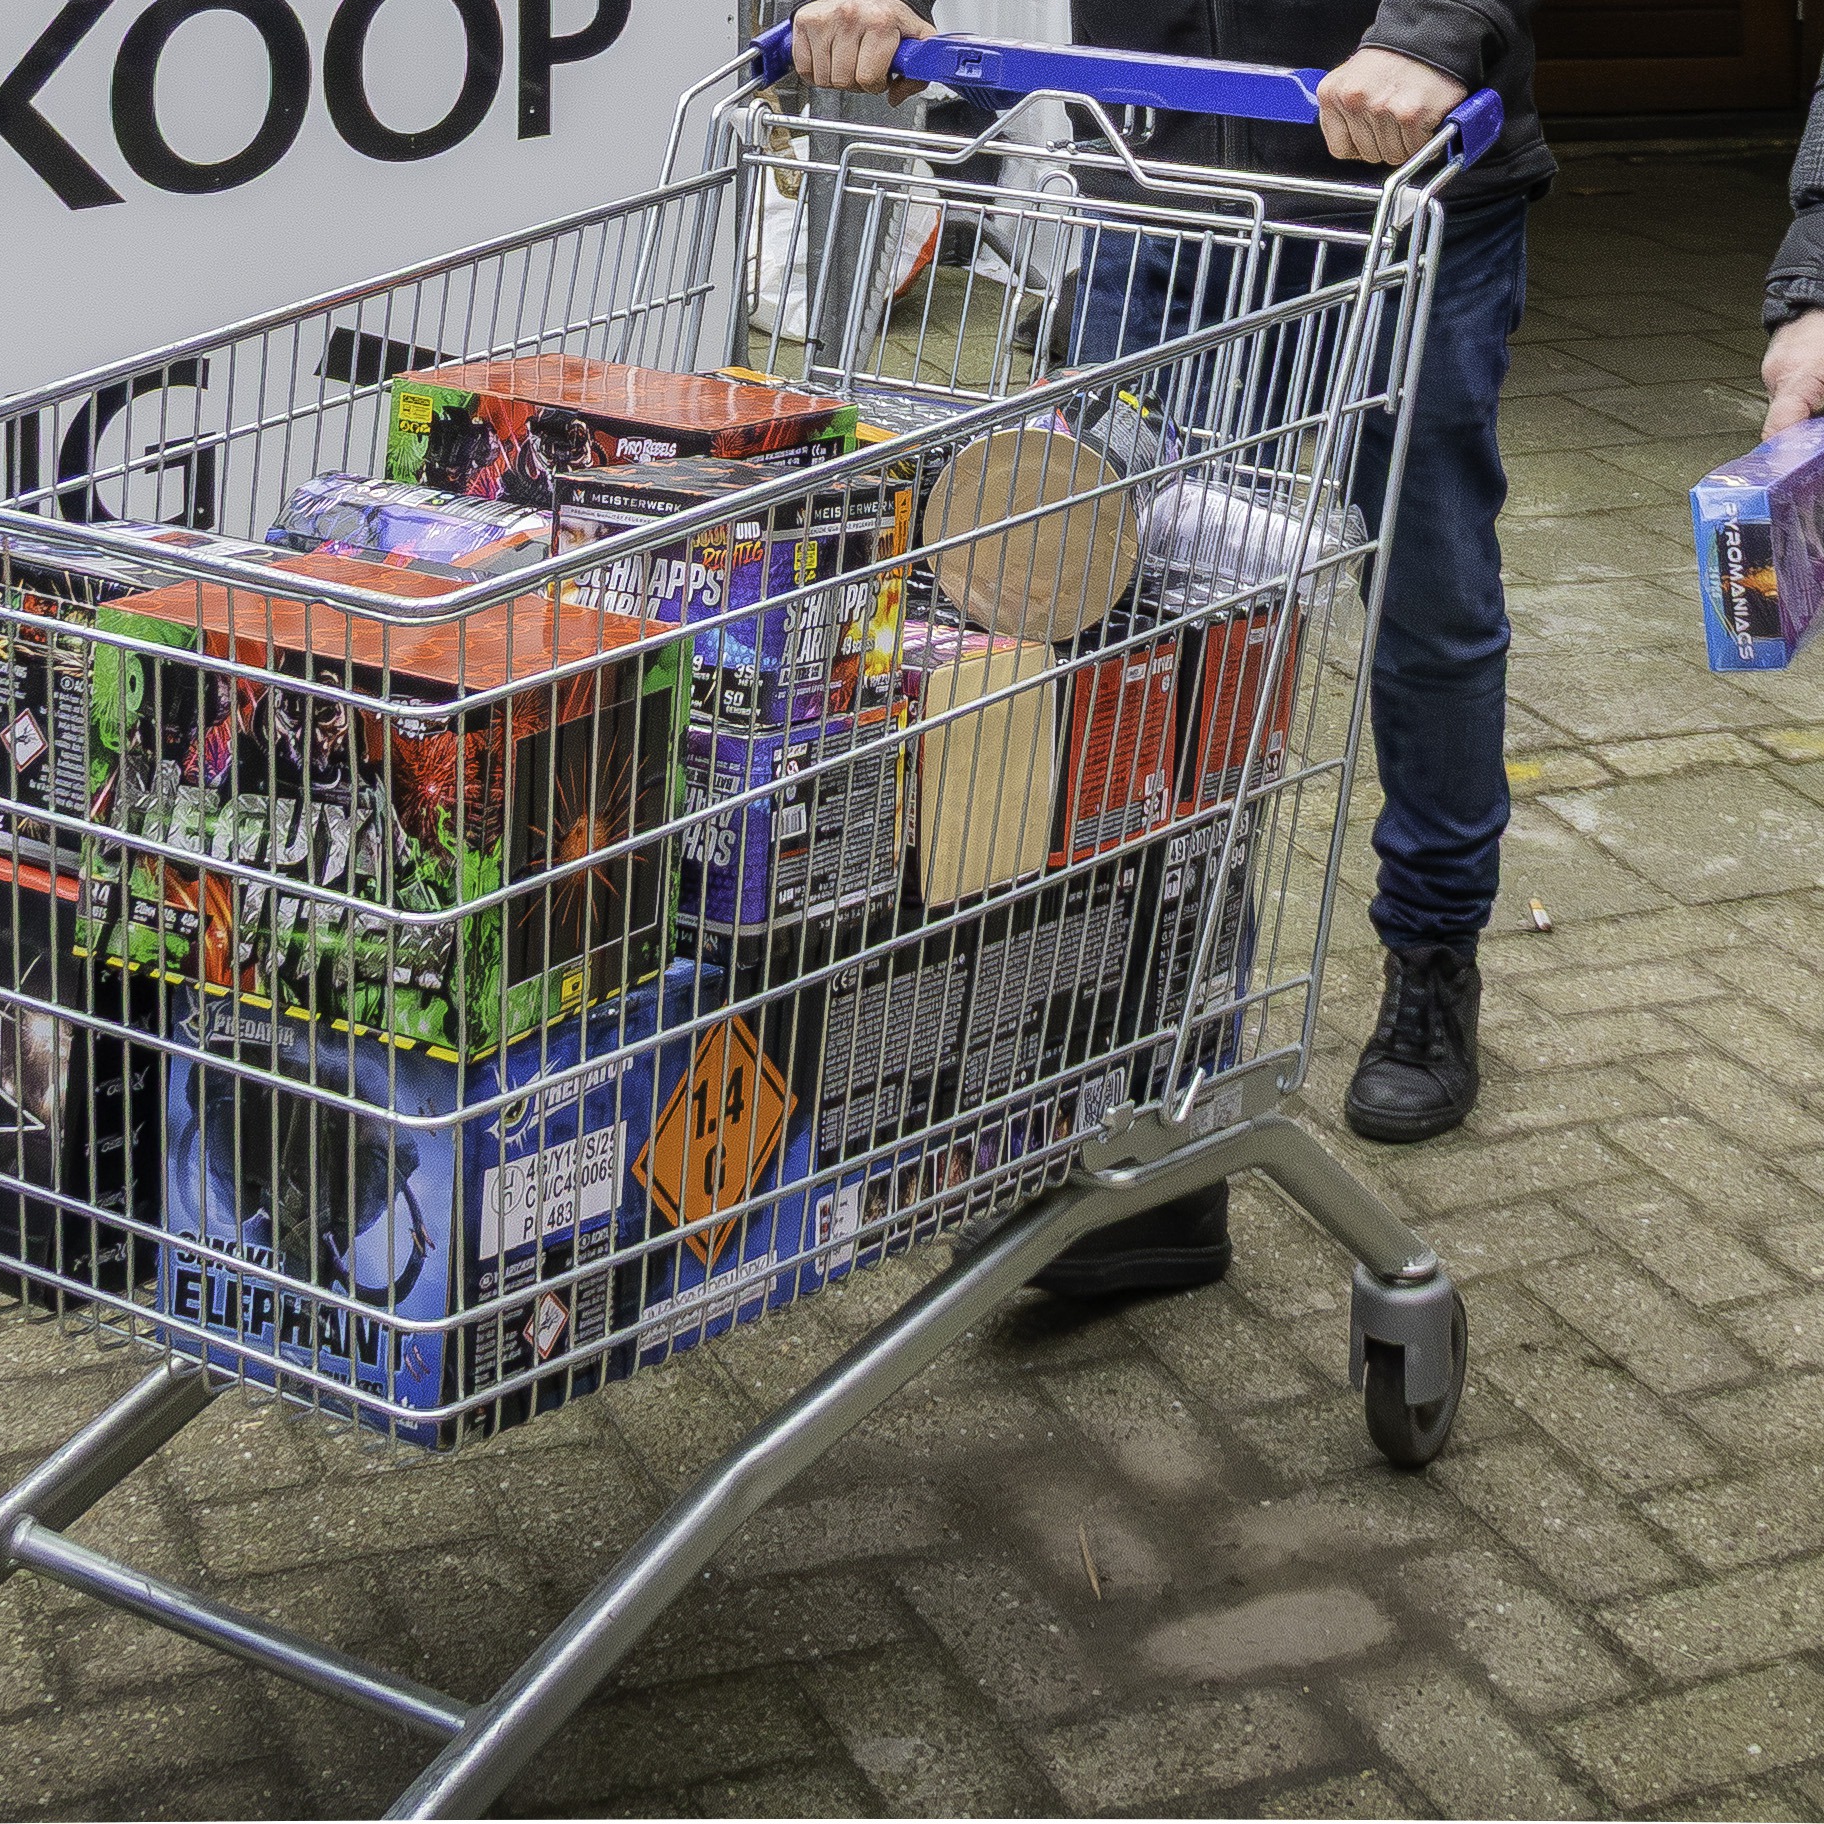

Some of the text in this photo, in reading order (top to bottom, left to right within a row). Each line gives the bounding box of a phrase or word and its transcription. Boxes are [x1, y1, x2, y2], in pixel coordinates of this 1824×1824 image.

[591, 492, 682, 513] MEISTERWERK
[813, 500, 895, 521] MEISERWERK
[735, 521, 761, 540] UND
[1723, 500, 1755, 662] PYROMANIACS
[691, 1064, 745, 1141] 1.4
